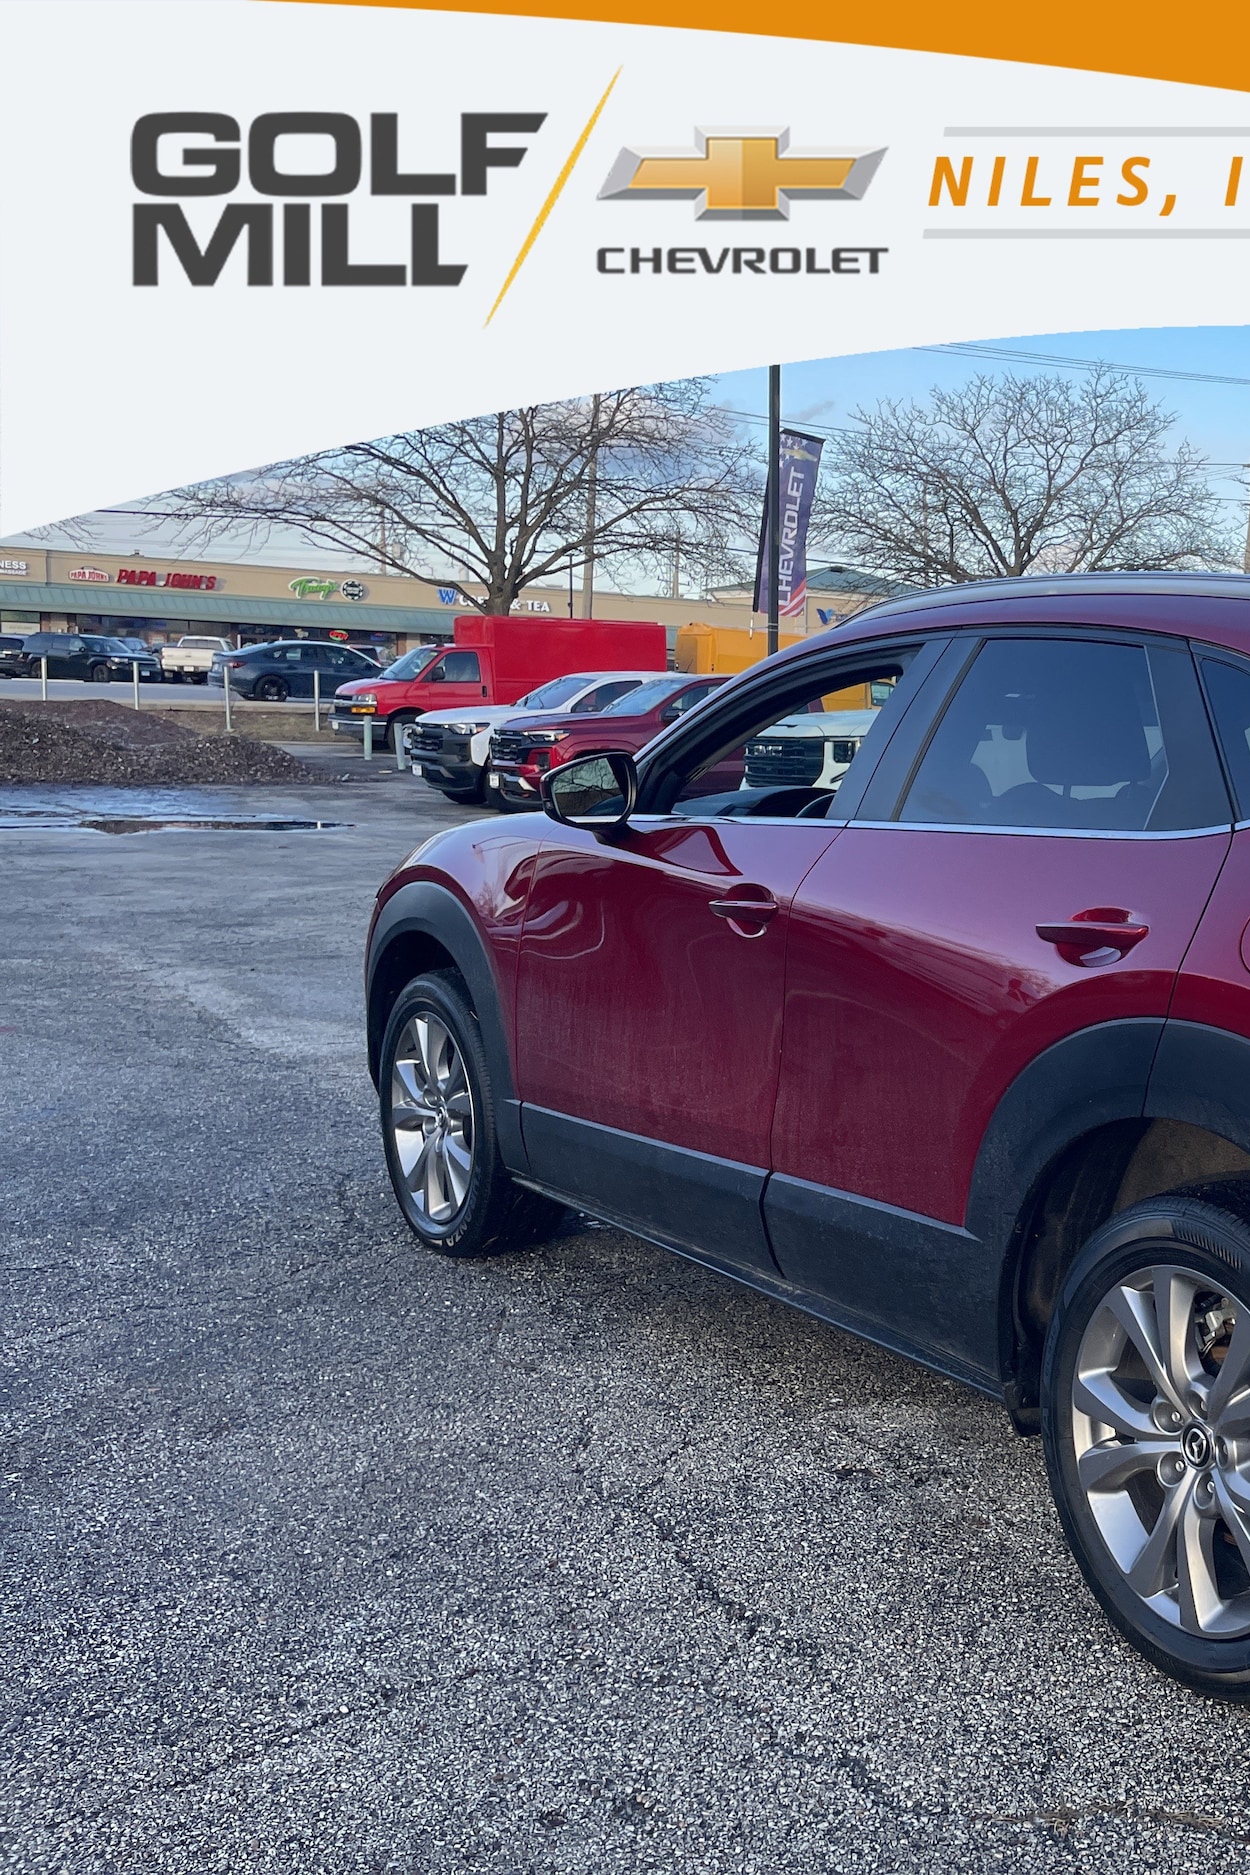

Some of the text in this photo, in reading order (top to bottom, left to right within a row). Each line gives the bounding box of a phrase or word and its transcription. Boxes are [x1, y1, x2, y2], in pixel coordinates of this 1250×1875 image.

[778, 466, 805, 606] CHEVROLET
[71, 571, 86, 580] PAPA
[117, 569, 156, 586] PAPA
[526, 600, 550, 612] TEA
